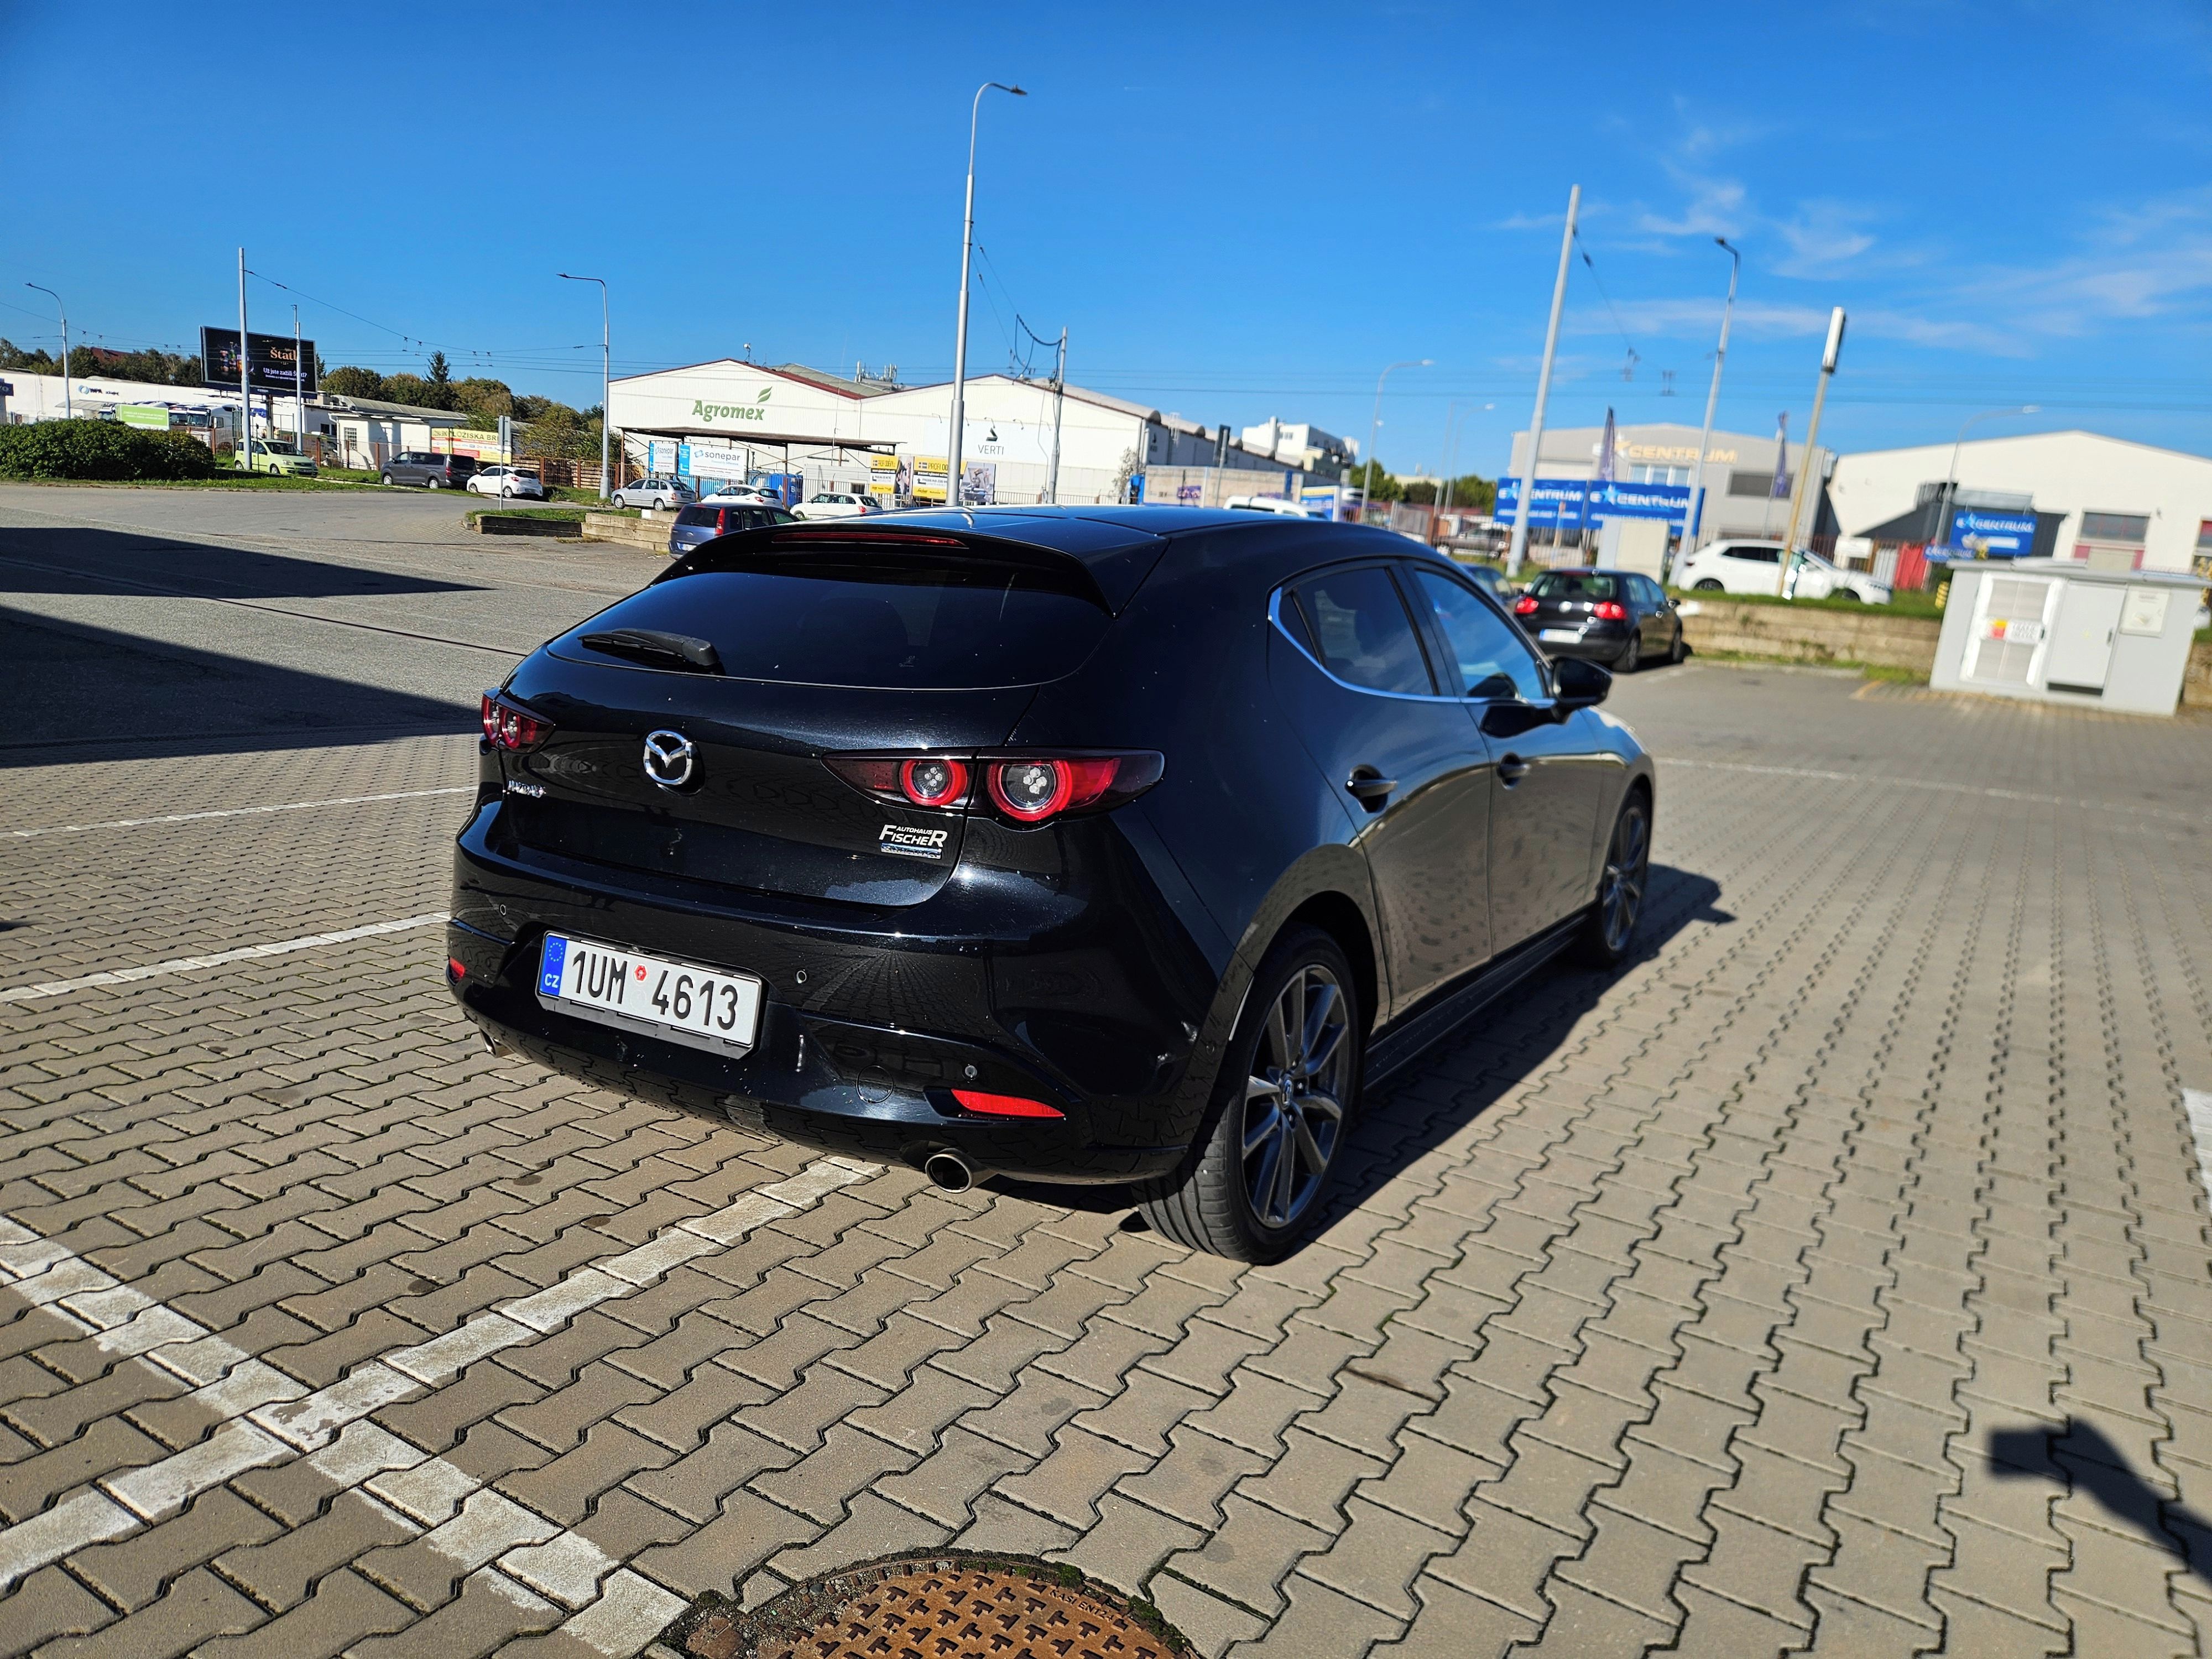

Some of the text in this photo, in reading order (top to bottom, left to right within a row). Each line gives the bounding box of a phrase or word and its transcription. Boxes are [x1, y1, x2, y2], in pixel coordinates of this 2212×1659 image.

[692, 400, 765, 422] Agromex
[452, 431, 484, 440] LOŽISKA
[705, 451, 741, 461] sonepar
[978, 444, 1004, 455] VERTI
[879, 824, 948, 848] FISCHER
[896, 826, 933, 835] AUTOHAUS
[544, 973, 560, 988] CZ
[572, 950, 738, 1030] 1UM 4613
[1050, 1589, 1077, 1606] KASI
